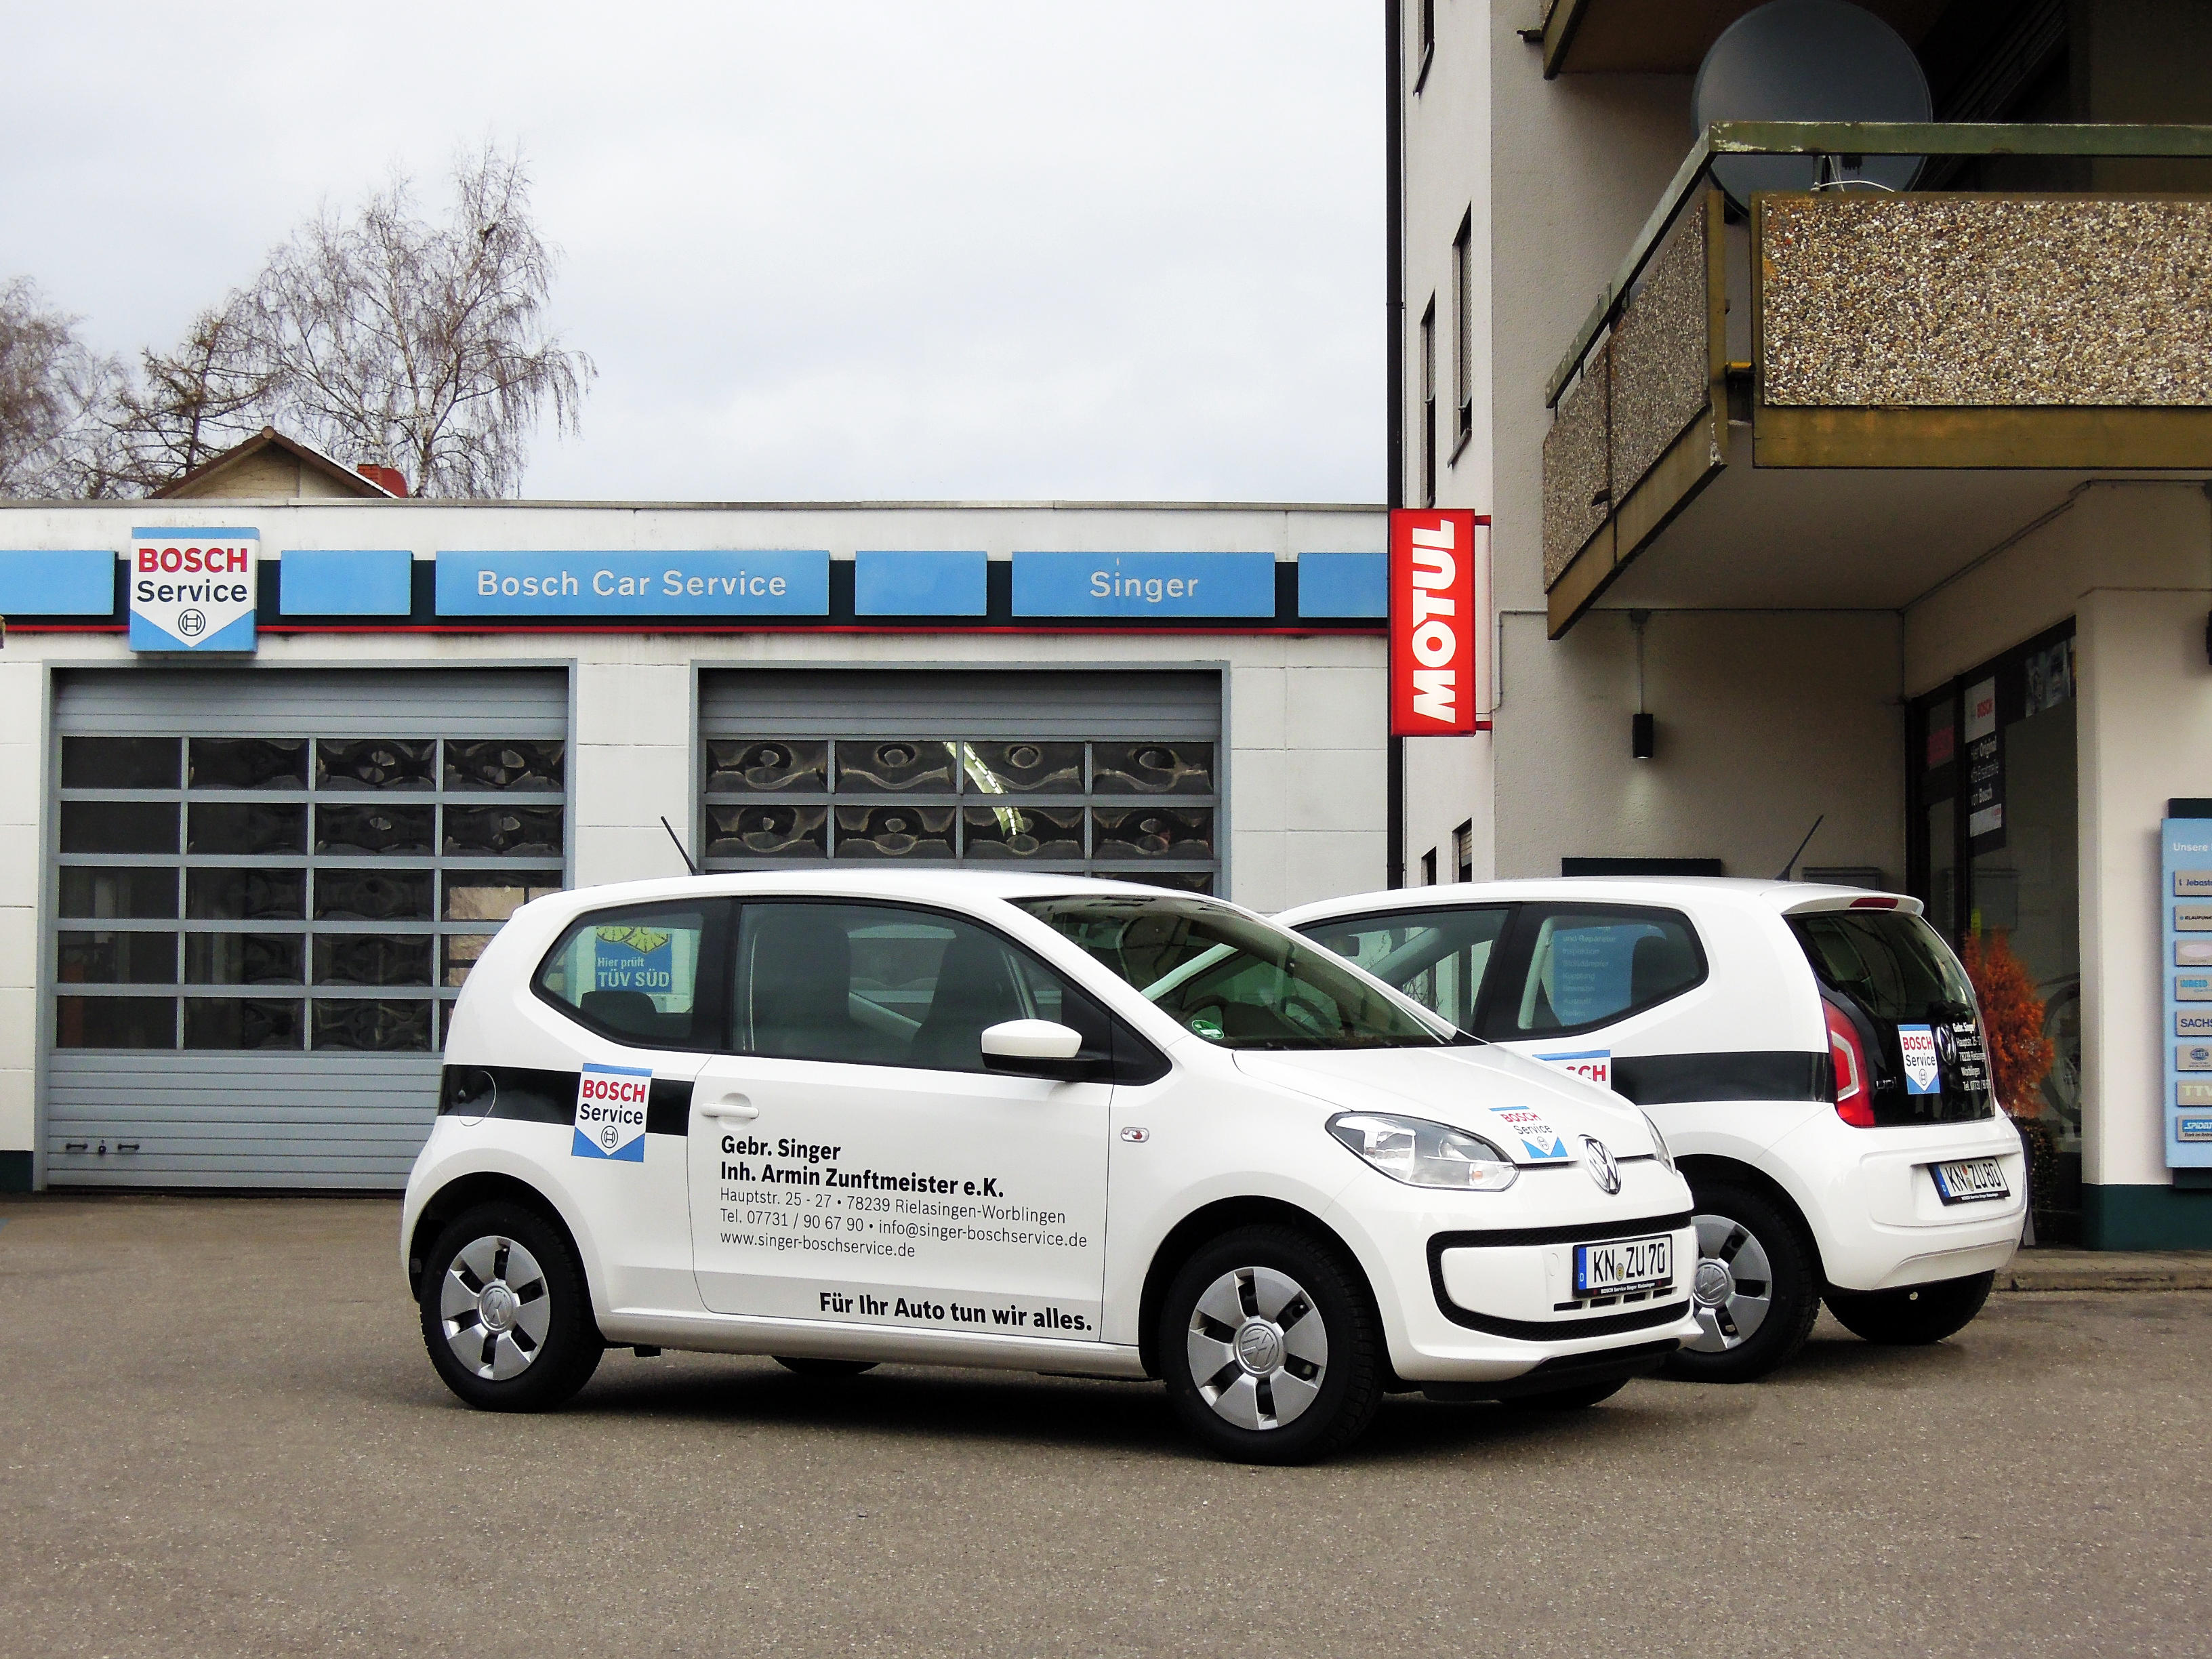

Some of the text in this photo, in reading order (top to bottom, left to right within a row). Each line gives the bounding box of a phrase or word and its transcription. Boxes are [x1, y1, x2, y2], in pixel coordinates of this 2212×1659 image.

[138, 548, 247, 573] BOSCH
[137, 579, 247, 602] Service
[477, 569, 787, 596] Bosch Car Service
[1089, 570, 1198, 602] Singer
[1412, 519, 1456, 723] MOTUL
[2173, 842, 2208, 851] Unsere
[597, 957, 644, 968] Hier prüft
[598, 968, 670, 987] TÜV SÜD
[1902, 1037, 1933, 1050] BOSCH
[1905, 1053, 1936, 1067] Service
[582, 1080, 646, 1103] BOSCH
[579, 1103, 643, 1125] Service
[1500, 1112, 1542, 1122] BOSCH
[1513, 1124, 1553, 1134] Service
[721, 1135, 841, 1164] Gebr. Singer
[721, 1161, 1004, 1197] Inh. Armin Zunftmeister e.K.
[1945, 1166, 1969, 1192] KN
[1967, 1164, 1988, 1189] ZU
[1983, 1163, 2002, 1187] 80
[720, 1187, 780, 1205] Hauptstr.
[785, 1192, 802, 1206] 25
[815, 1194, 832, 1208] 27
[846, 1196, 890, 1212] 78239
[895, 1199, 1065, 1225] Rielasingen-Worblingen
[720, 1208, 742, 1223] Tel.
[747, 1210, 788, 1226] 07731
[803, 1214, 820, 1229] 90
[825, 1216, 842, 1230] 67
[846, 1218, 864, 1231] 90
[879, 1220, 1087, 1247] info@singer-boschservice.de
[720, 1233, 916, 1257] www.singer-boschservice.de
[1593, 1249, 1615, 1283] KN
[1626, 1246, 1645, 1277] ZU
[1649, 1242, 1665, 1275] 70
[819, 1292, 1092, 1330] Für Ihr Auto tun wir alles.
